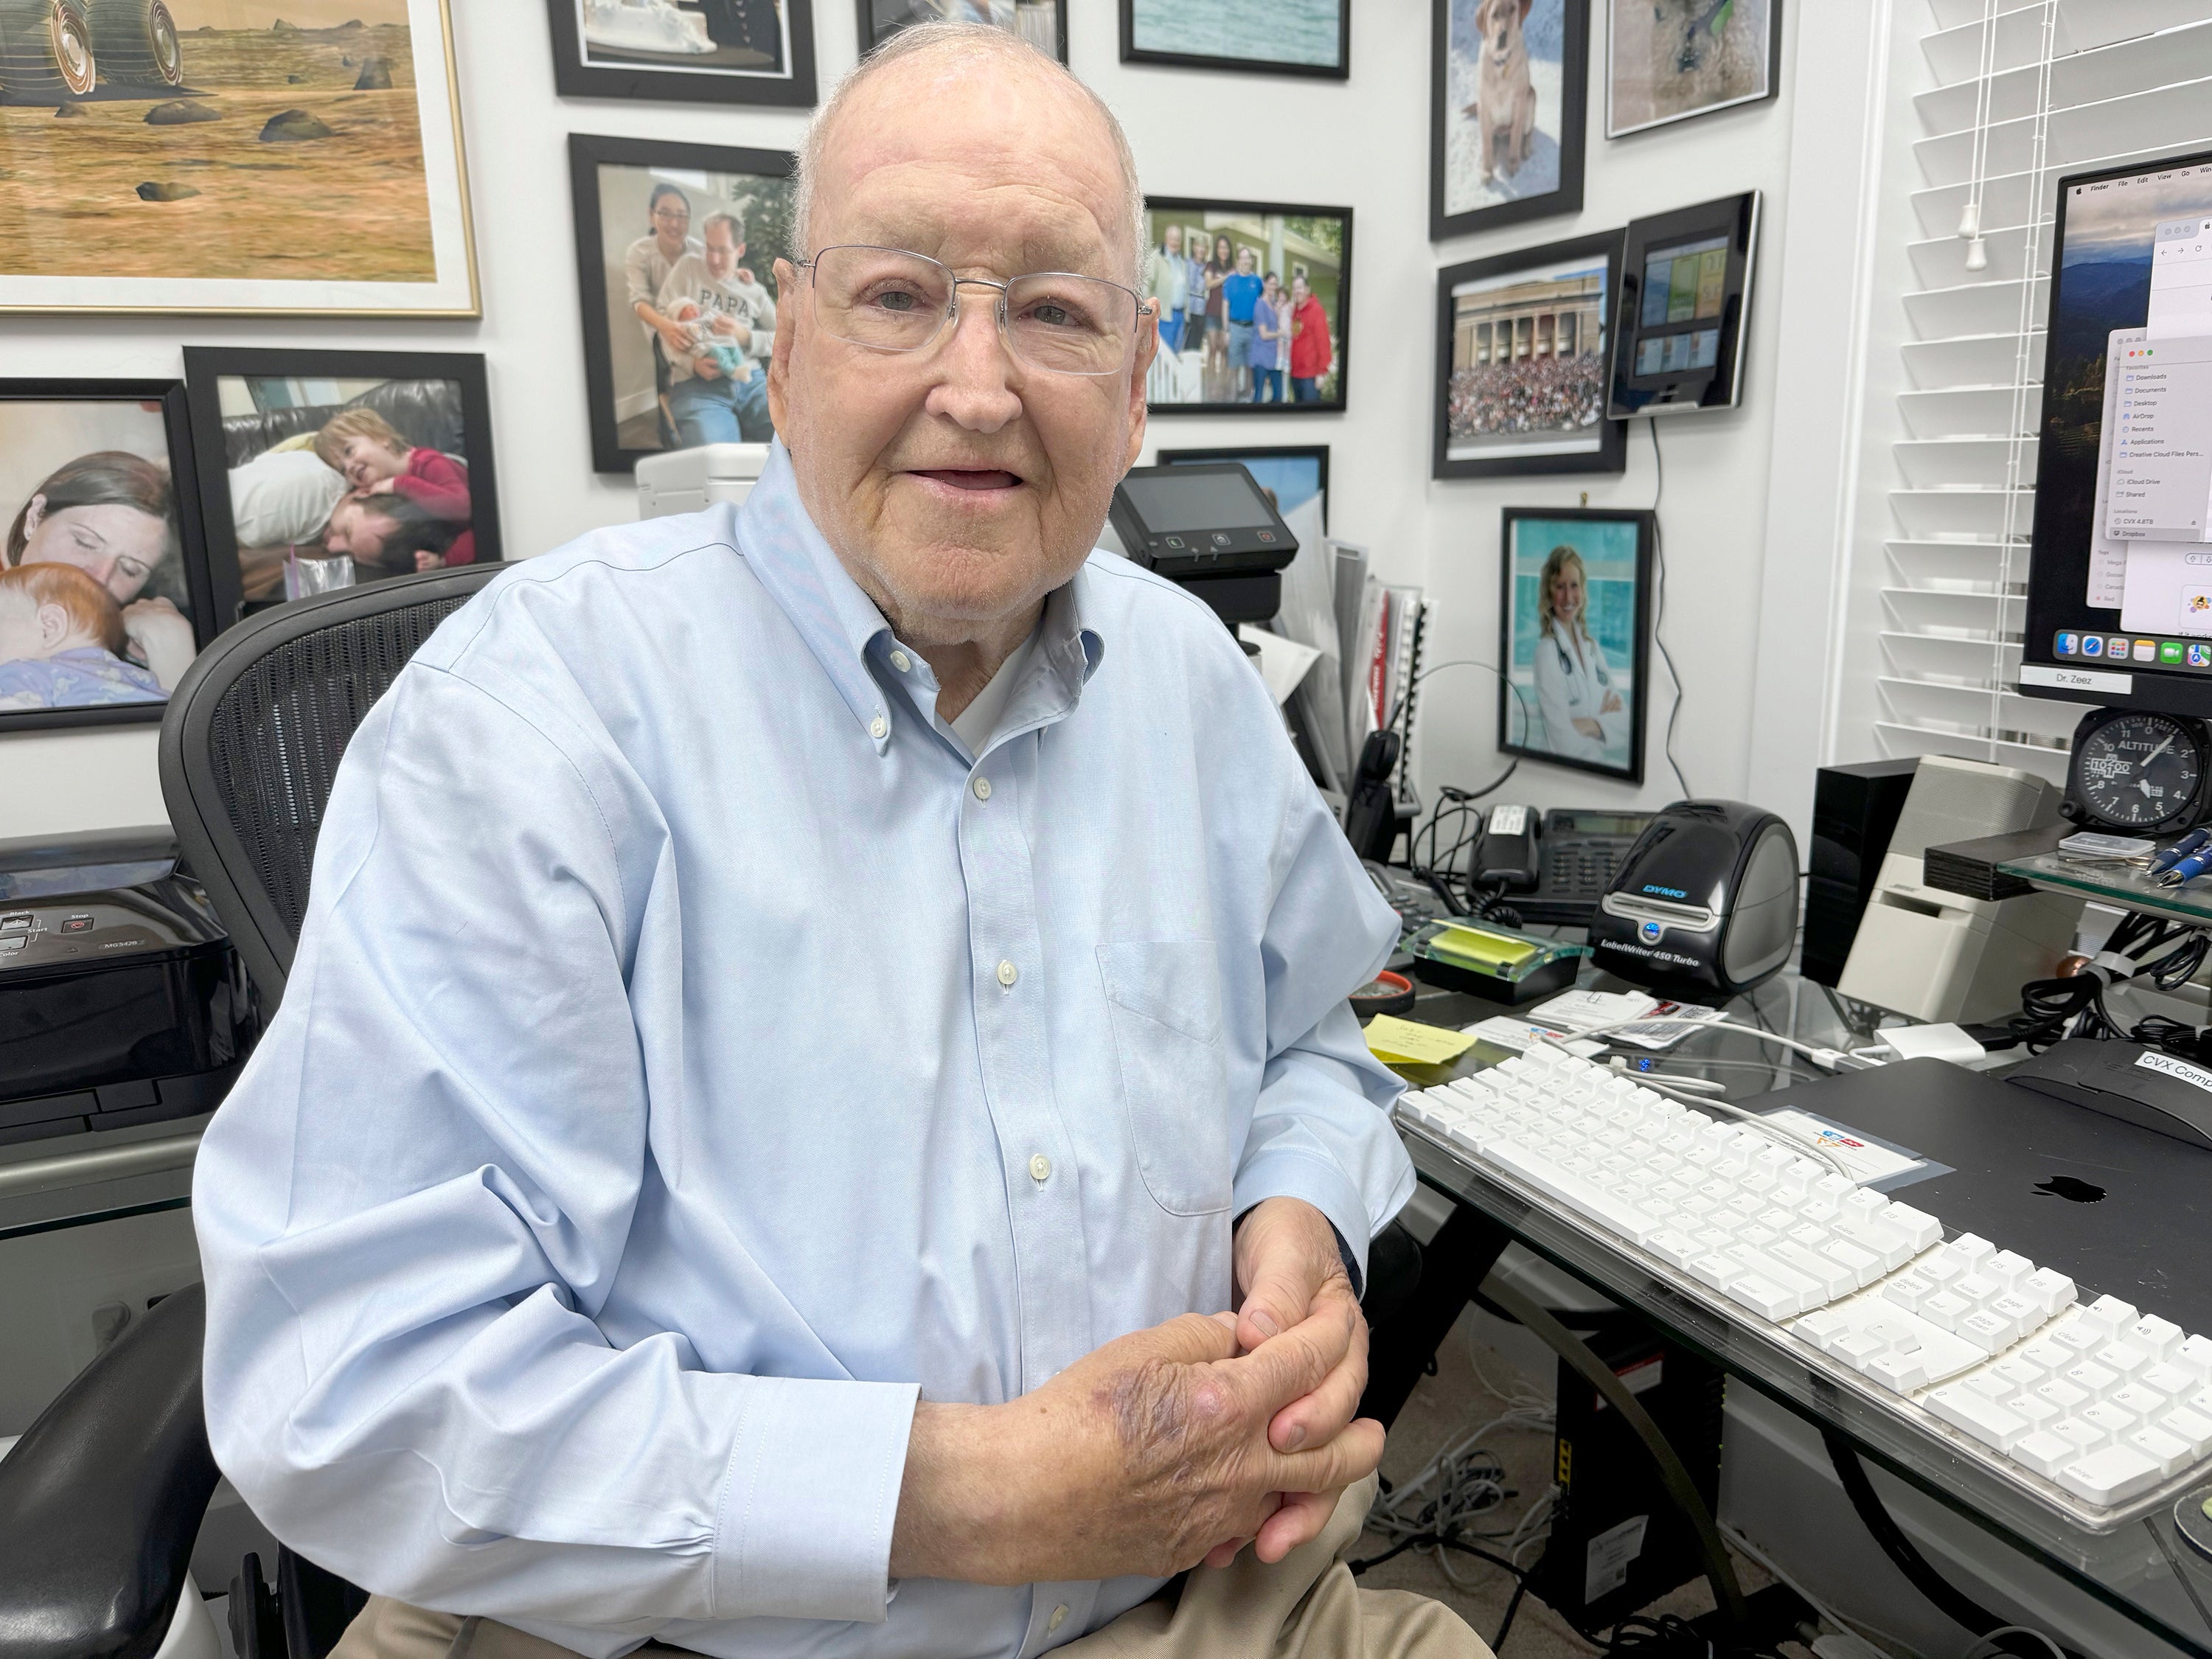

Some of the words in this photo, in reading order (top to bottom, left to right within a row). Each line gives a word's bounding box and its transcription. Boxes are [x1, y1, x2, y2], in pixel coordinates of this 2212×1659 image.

[2090, 184, 2109, 192] Finder
[700, 289, 749, 317] PAPA
[2056, 673, 2067, 682] Dr.
[2070, 675, 2092, 684] Zeez
[2103, 742, 2115, 752] 10
[2180, 749, 2188, 758] 2
[2180, 771, 2189, 779] 3
[2097, 780, 2105, 789] 8
[2173, 790, 2181, 799] 4
[2112, 796, 2120, 805] 7
[2132, 804, 2140, 813] 6
[2154, 801, 2163, 811] 5
[1643, 885, 1687, 899] DYMO
[105, 940, 138, 949] MG5420
[1601, 939, 1652, 956] LabelWriter
[1653, 950, 1672, 961] 450
[1673, 954, 1700, 967] Turbo
[2143, 1056, 2174, 1070] CVX
[2174, 1065, 2212, 1087] Comp
[1952, 1242, 1969, 1251] F14
[1920, 1265, 1938, 1275] help
[1990, 1261, 2006, 1269] F15
[1736, 1282, 1762, 1294] control
[1899, 1279, 1923, 1290] delete
[2028, 1279, 2046, 1287] F16
[1958, 1283, 1979, 1295] home
[1929, 1300, 1947, 1309] end
[2003, 1298, 2023, 1309] page
[1967, 1319, 1989, 1331] down
[1973, 1315, 1994, 1326] page
[2058, 1332, 2080, 1343] clear
[2068, 1466, 2095, 1480] enter
